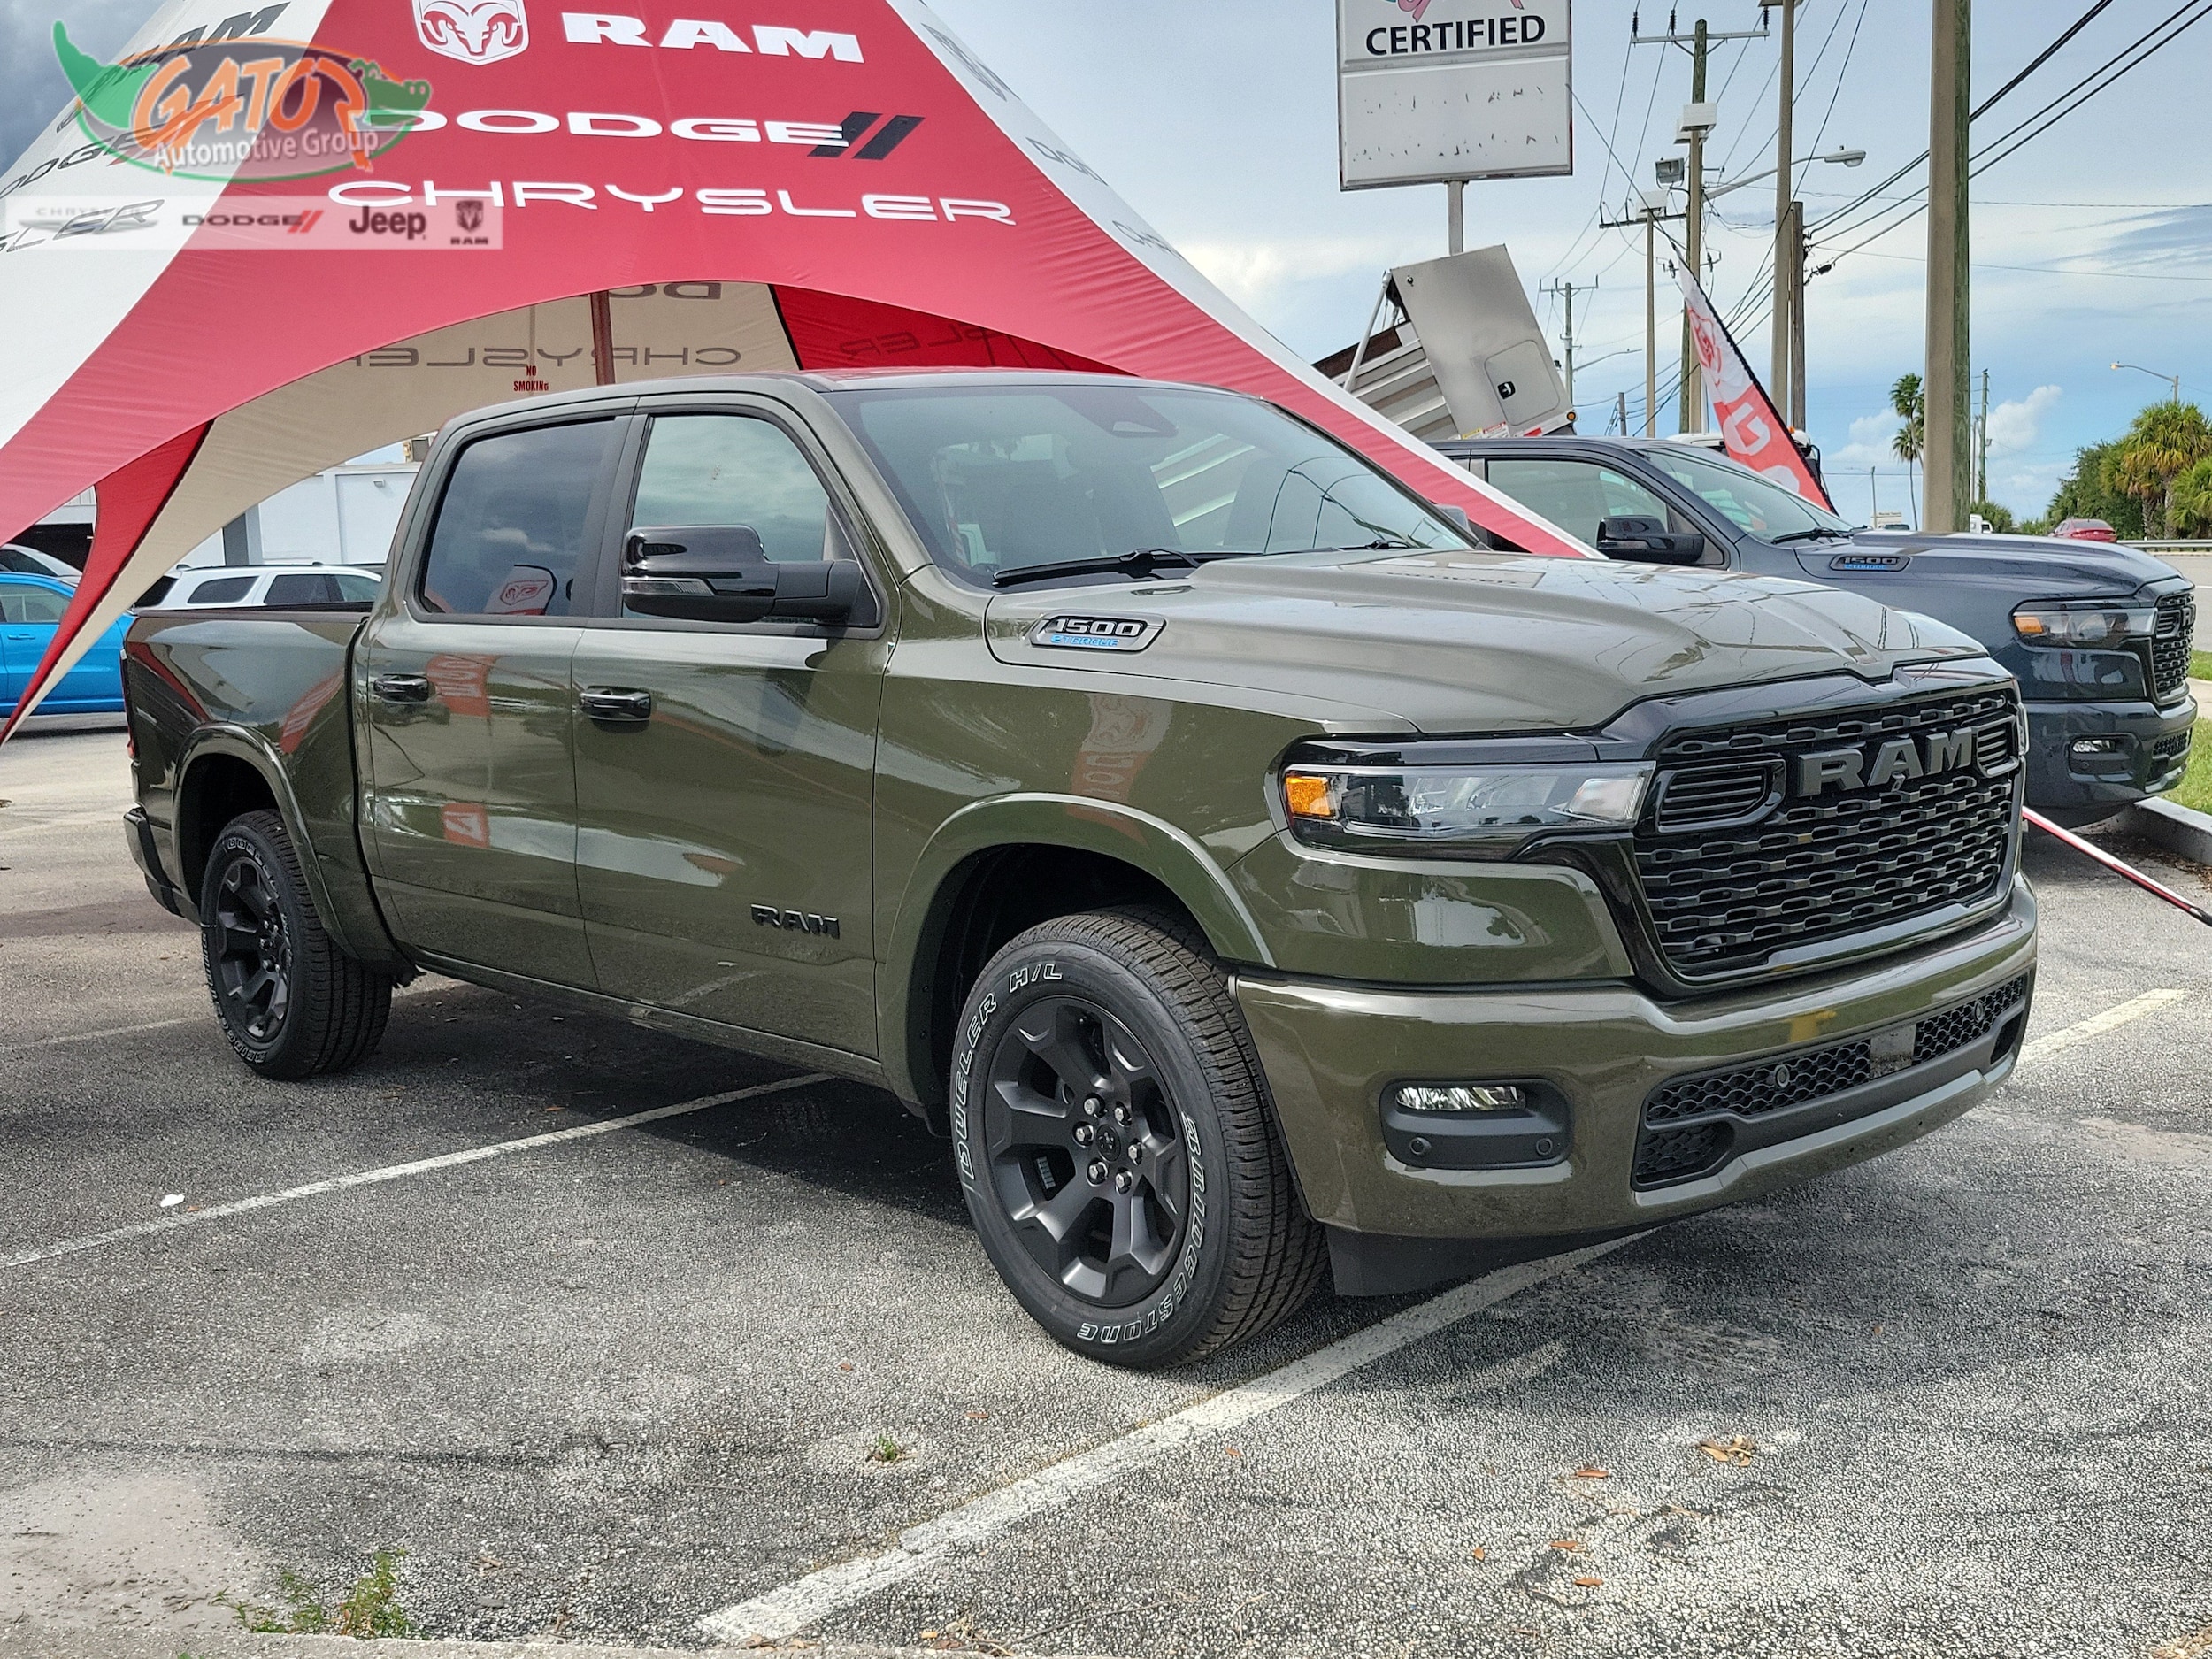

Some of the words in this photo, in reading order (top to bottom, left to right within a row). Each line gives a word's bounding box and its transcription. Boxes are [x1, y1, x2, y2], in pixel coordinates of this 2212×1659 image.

[564, 12, 864, 64] RAM
[1365, 15, 1546, 56] CERTIFIED
[348, 109, 849, 147] DODGE
[329, 180, 1017, 227] CHRYSLER
[513, 380, 549, 392] SMOKING
[526, 365, 537, 377] NO
[1843, 557, 1898, 565] 1500
[1045, 618, 1144, 638] 1500
[1798, 726, 1973, 797] RAM
[749, 903, 841, 940] RAM
[955, 993, 998, 1181] DUELER
[1009, 963, 1063, 994] H/L
[1076, 1110, 1206, 1344] BRIDGESTONE
